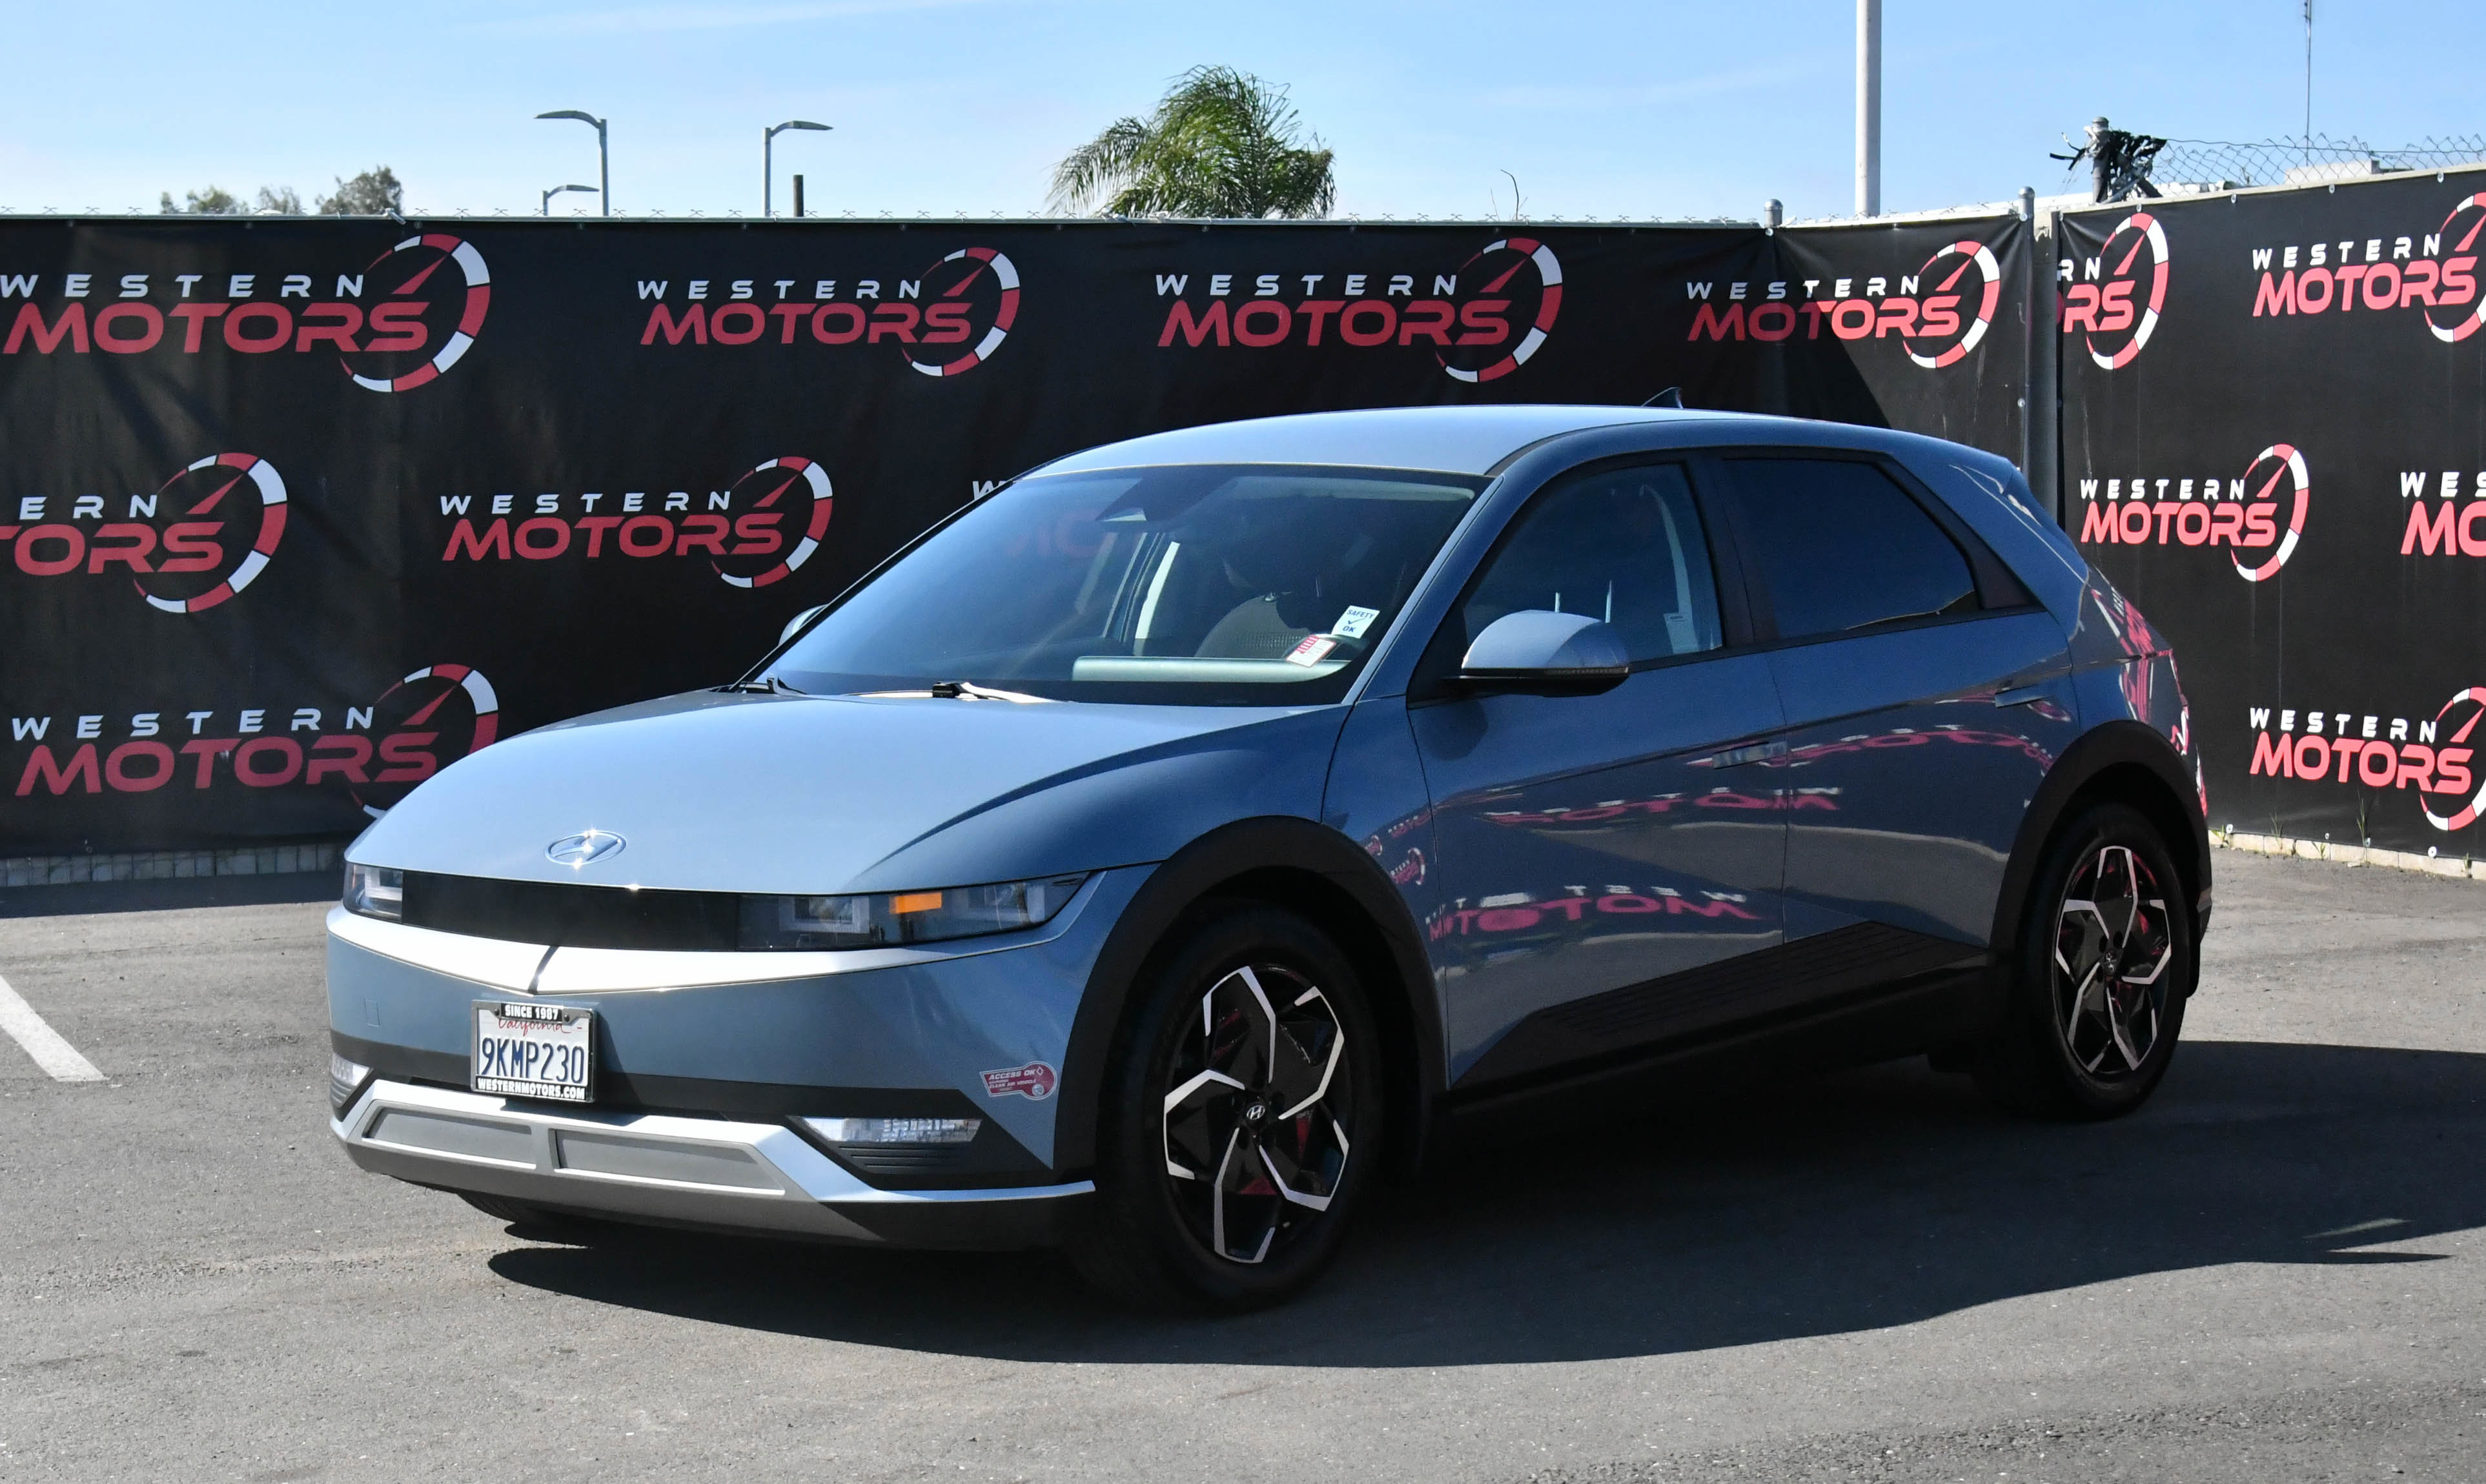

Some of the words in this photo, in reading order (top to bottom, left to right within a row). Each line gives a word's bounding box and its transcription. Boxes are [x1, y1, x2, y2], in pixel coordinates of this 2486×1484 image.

[2252, 233, 2440, 270] WESTERN
[0, 274, 363, 298] WESTERN
[638, 280, 921, 300] WESTERN
[1156, 275, 1456, 296] WESTERN
[1686, 276, 1919, 300] WESTERN
[2252, 256, 2478, 316] MOTORS
[640, 302, 973, 345] MOTORS
[1157, 300, 1512, 347] MOTORS
[1687, 295, 1961, 341] MOTORS
[2057, 280, 2135, 333] RS
[3, 301, 430, 354] MOTORS
[19, 494, 158, 520] ERN
[440, 491, 730, 515] WESTERN
[2080, 479, 2245, 500] WESTERN
[442, 513, 785, 561] MOTORS
[2081, 500, 2277, 546] MOTORS
[1347, 609, 1374, 618] SAFETY
[12, 706, 373, 741] WESTERN
[2249, 707, 2437, 742] WESTERN
[15, 732, 439, 796] MOTORS
[2249, 732, 2474, 795] MOTORS
[504, 1004, 533, 1018] SINCE
[535, 1008, 559, 1020] 1987
[482, 1037, 584, 1084] 9KMP230
[989, 1071, 1021, 1079] ACCESS
[478, 1078, 586, 1100] WESTERNMOTORS.COM
